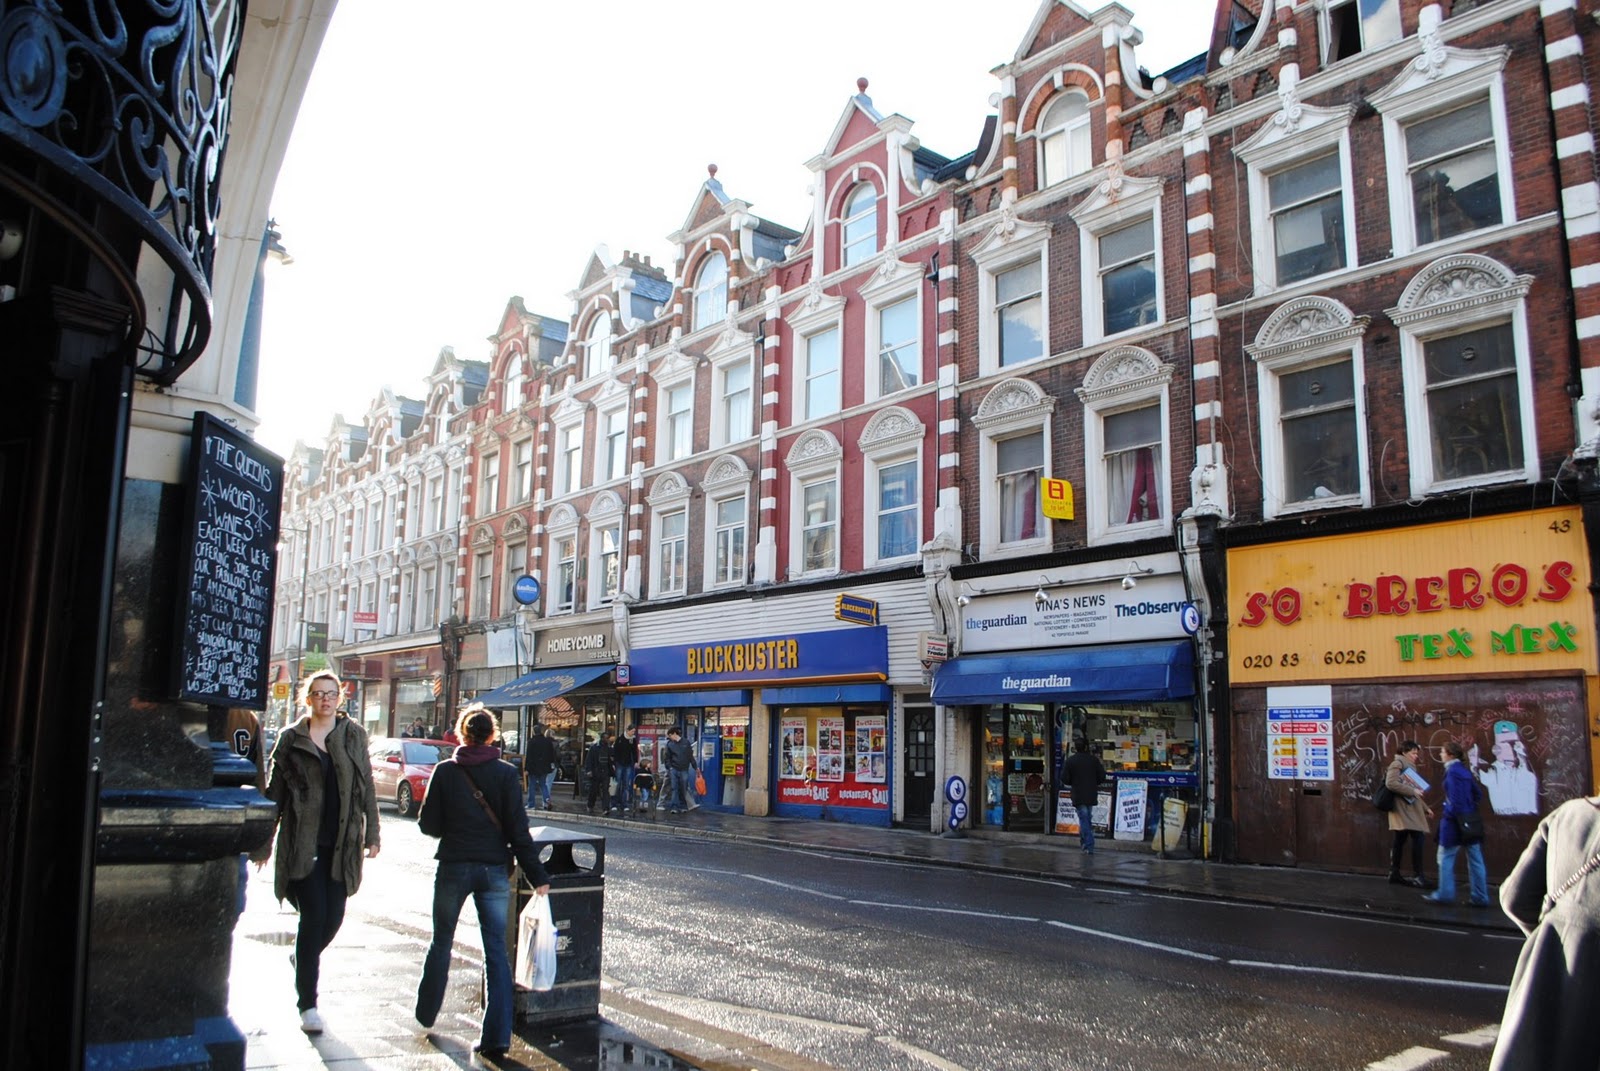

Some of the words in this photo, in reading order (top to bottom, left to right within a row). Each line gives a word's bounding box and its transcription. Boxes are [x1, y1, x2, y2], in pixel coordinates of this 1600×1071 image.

[213, 436, 236, 467] THE
[235, 450, 272, 492] QUEENS
[218, 478, 255, 514] WICKED
[214, 506, 254, 541] WINES
[1548, 520, 1572, 534] 43
[195, 542, 230, 570] OFFERING
[198, 521, 222, 547] EACH
[226, 533, 247, 560] WEEK
[194, 558, 210, 575] OUR
[192, 573, 204, 589] AT
[206, 579, 238, 605] AMAZING
[1035, 598, 1070, 612] VINA'S
[1074, 594, 1106, 608] NEWS
[1241, 587, 1302, 627] SO
[1344, 561, 1574, 619] BREROS
[548, 634, 605, 653] HONEYCOMB
[687, 639, 798, 674] BLOCKBUSTER
[1396, 628, 1474, 661] TEX
[1491, 621, 1578, 655] MEX
[1243, 655, 1272, 670] 020
[1280, 653, 1300, 668] 83
[1324, 650, 1366, 666] 6026
[813, 786, 829, 801] SALE
